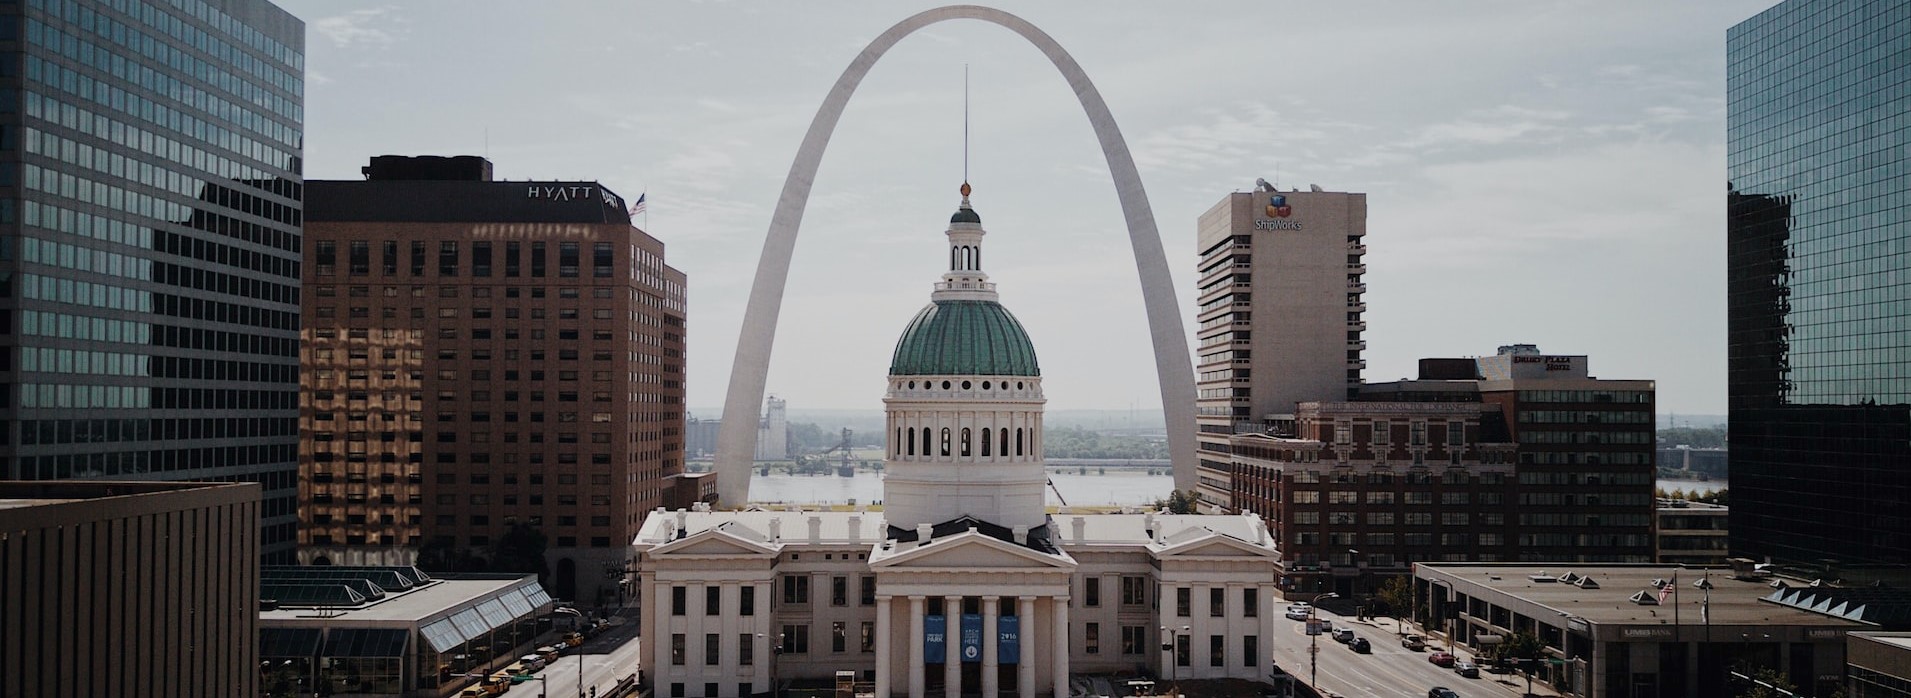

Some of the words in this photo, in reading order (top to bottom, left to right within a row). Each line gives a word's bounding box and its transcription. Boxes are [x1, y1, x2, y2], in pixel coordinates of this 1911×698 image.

[528, 186, 593, 202] HYATT
[1255, 219, 1302, 231] ShipWorks
[1624, 629, 1651, 638] UMB
[1651, 629, 1671, 637] BANK
